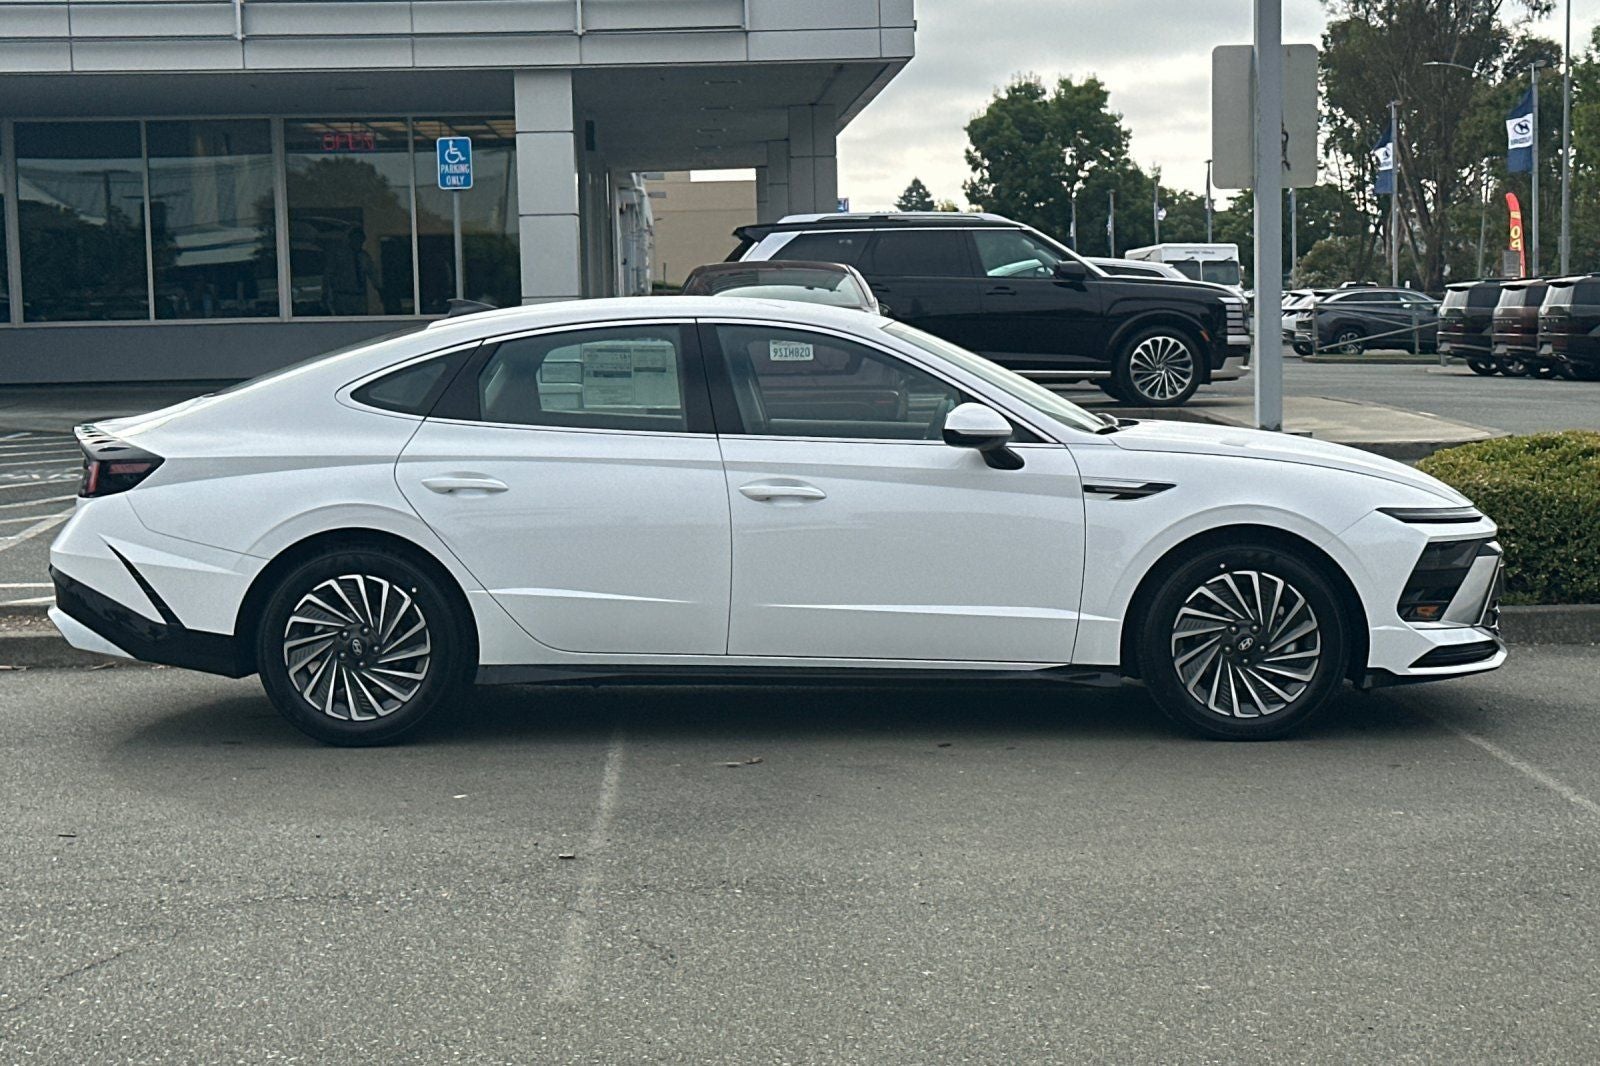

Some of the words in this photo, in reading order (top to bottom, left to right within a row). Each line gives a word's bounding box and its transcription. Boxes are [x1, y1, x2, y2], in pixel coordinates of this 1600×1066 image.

[322, 133, 375, 151] OPEN
[440, 163, 470, 174] PARKING
[446, 175, 465, 186] ONLY
